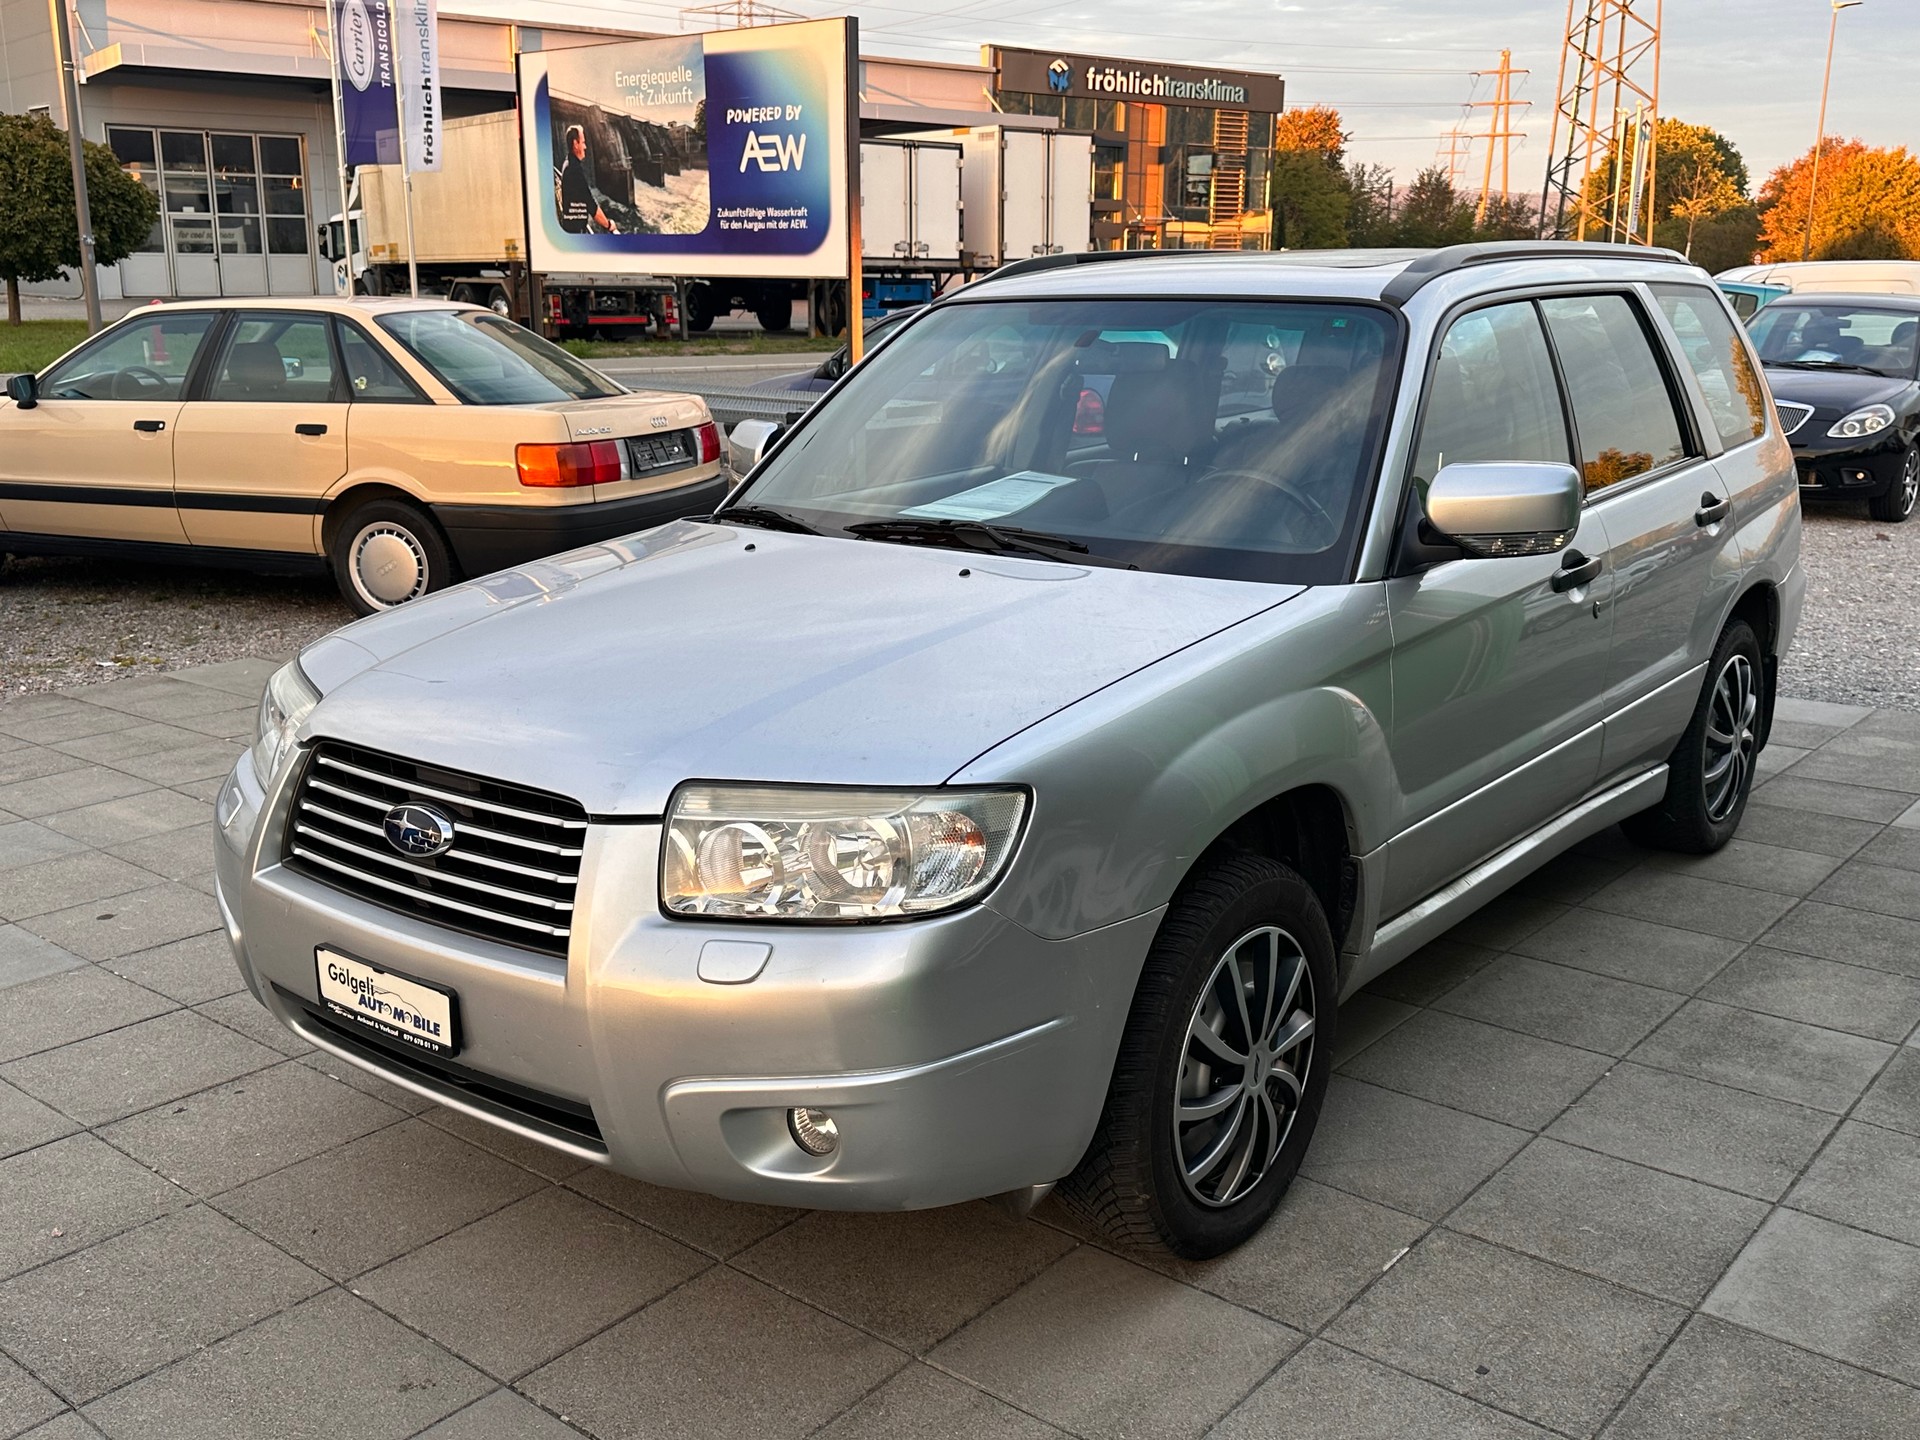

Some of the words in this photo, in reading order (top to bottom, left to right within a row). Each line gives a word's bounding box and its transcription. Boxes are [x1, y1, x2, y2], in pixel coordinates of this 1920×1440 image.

[350, 8, 365, 77] Carrier
[376, 1, 391, 88] TRANSICOLD
[615, 65, 692, 90] Energiequelle
[1086, 66, 1245, 103] fröhlichtransklima
[625, 91, 644, 107] mit
[646, 86, 693, 106] Zukunft
[726, 106, 782, 125] POWERED
[785, 104, 802, 121] BY
[739, 130, 807, 173] AEW
[717, 207, 766, 220] Zukunftsfähige
[766, 206, 808, 217] Wasserkraft
[720, 219, 730, 229] für
[730, 219, 742, 229] den
[743, 219, 766, 232] Aargau
[766, 219, 778, 229] mit
[778, 219, 790, 229] der
[790, 219, 808, 229] AEW.
[328, 962, 375, 997] Gölgeli
[358, 993, 441, 1038] AUTOMOBILE
